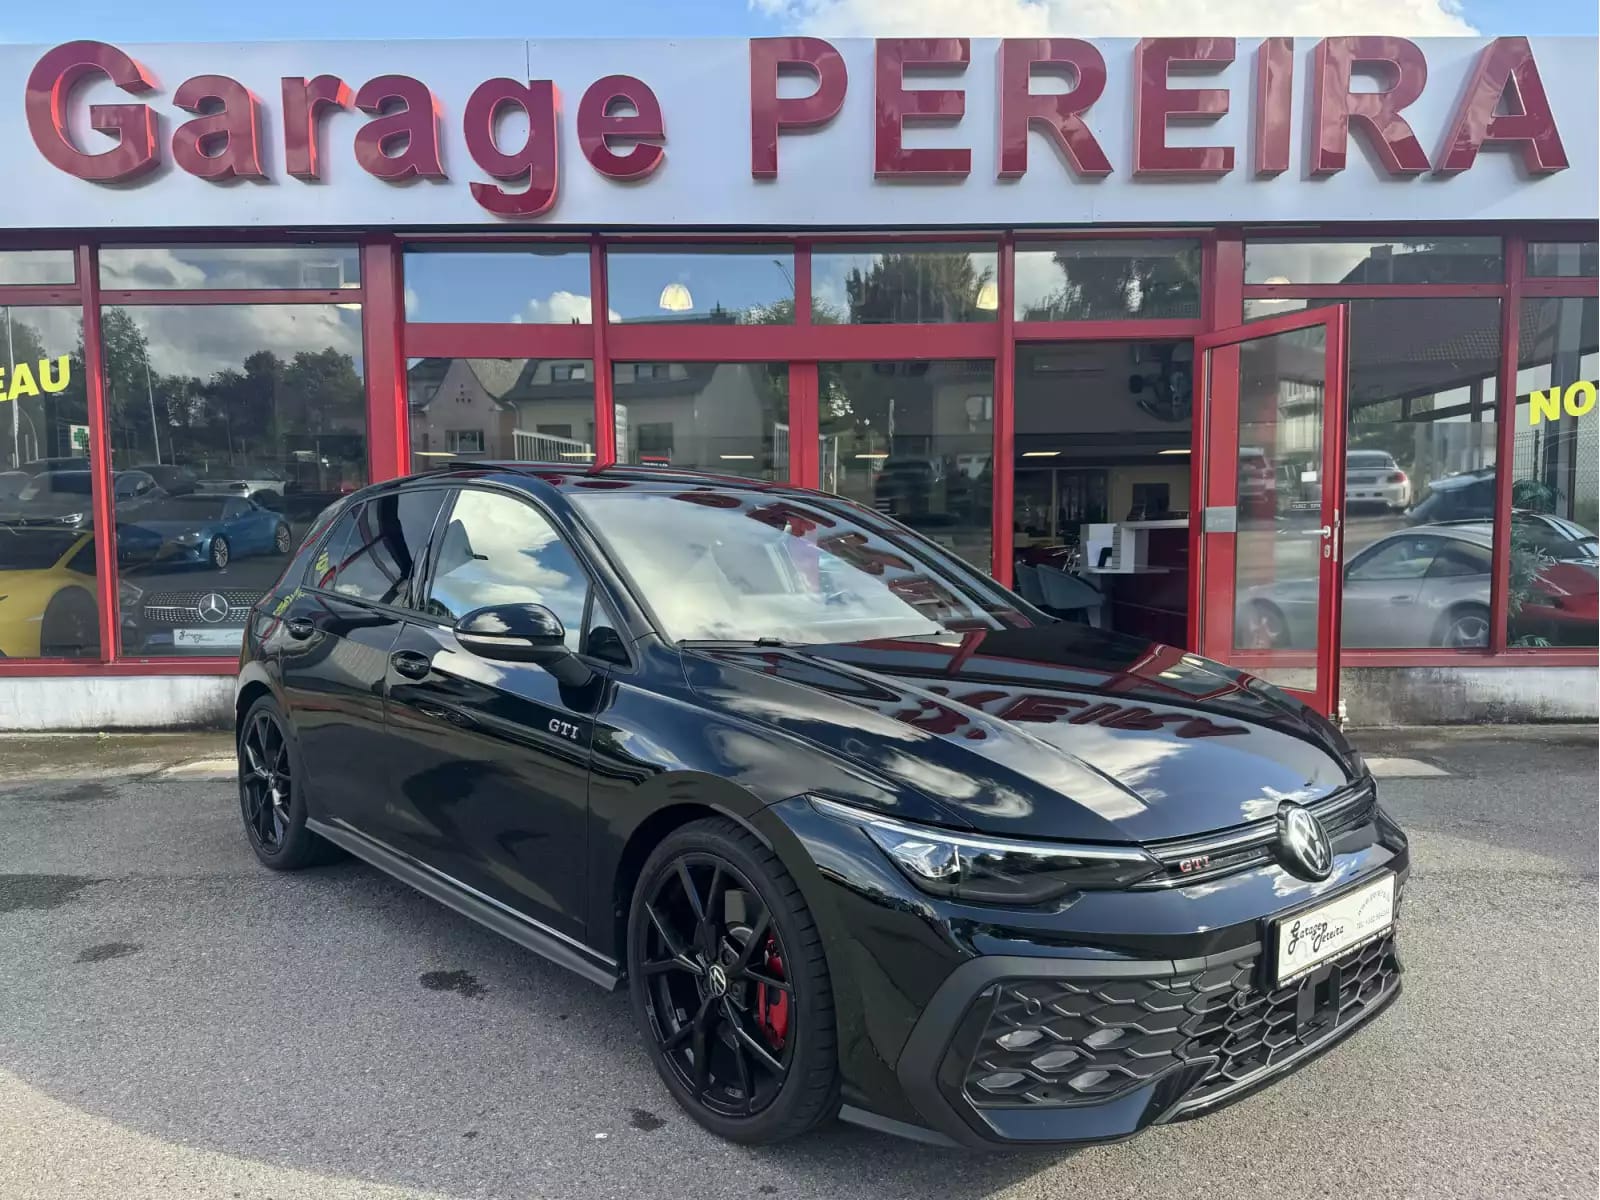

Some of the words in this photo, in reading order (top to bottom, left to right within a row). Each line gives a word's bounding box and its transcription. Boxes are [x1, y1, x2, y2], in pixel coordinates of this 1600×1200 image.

[25, 40, 667, 218] Garage
[749, 36, 1570, 181] PEREIRA
[1529, 380, 1597, 426] NO
[548, 718, 579, 739] GTI
[1179, 855, 1211, 873] GTI
[1288, 920, 1322, 956] Garage
[1313, 921, 1344, 953] Pereira
